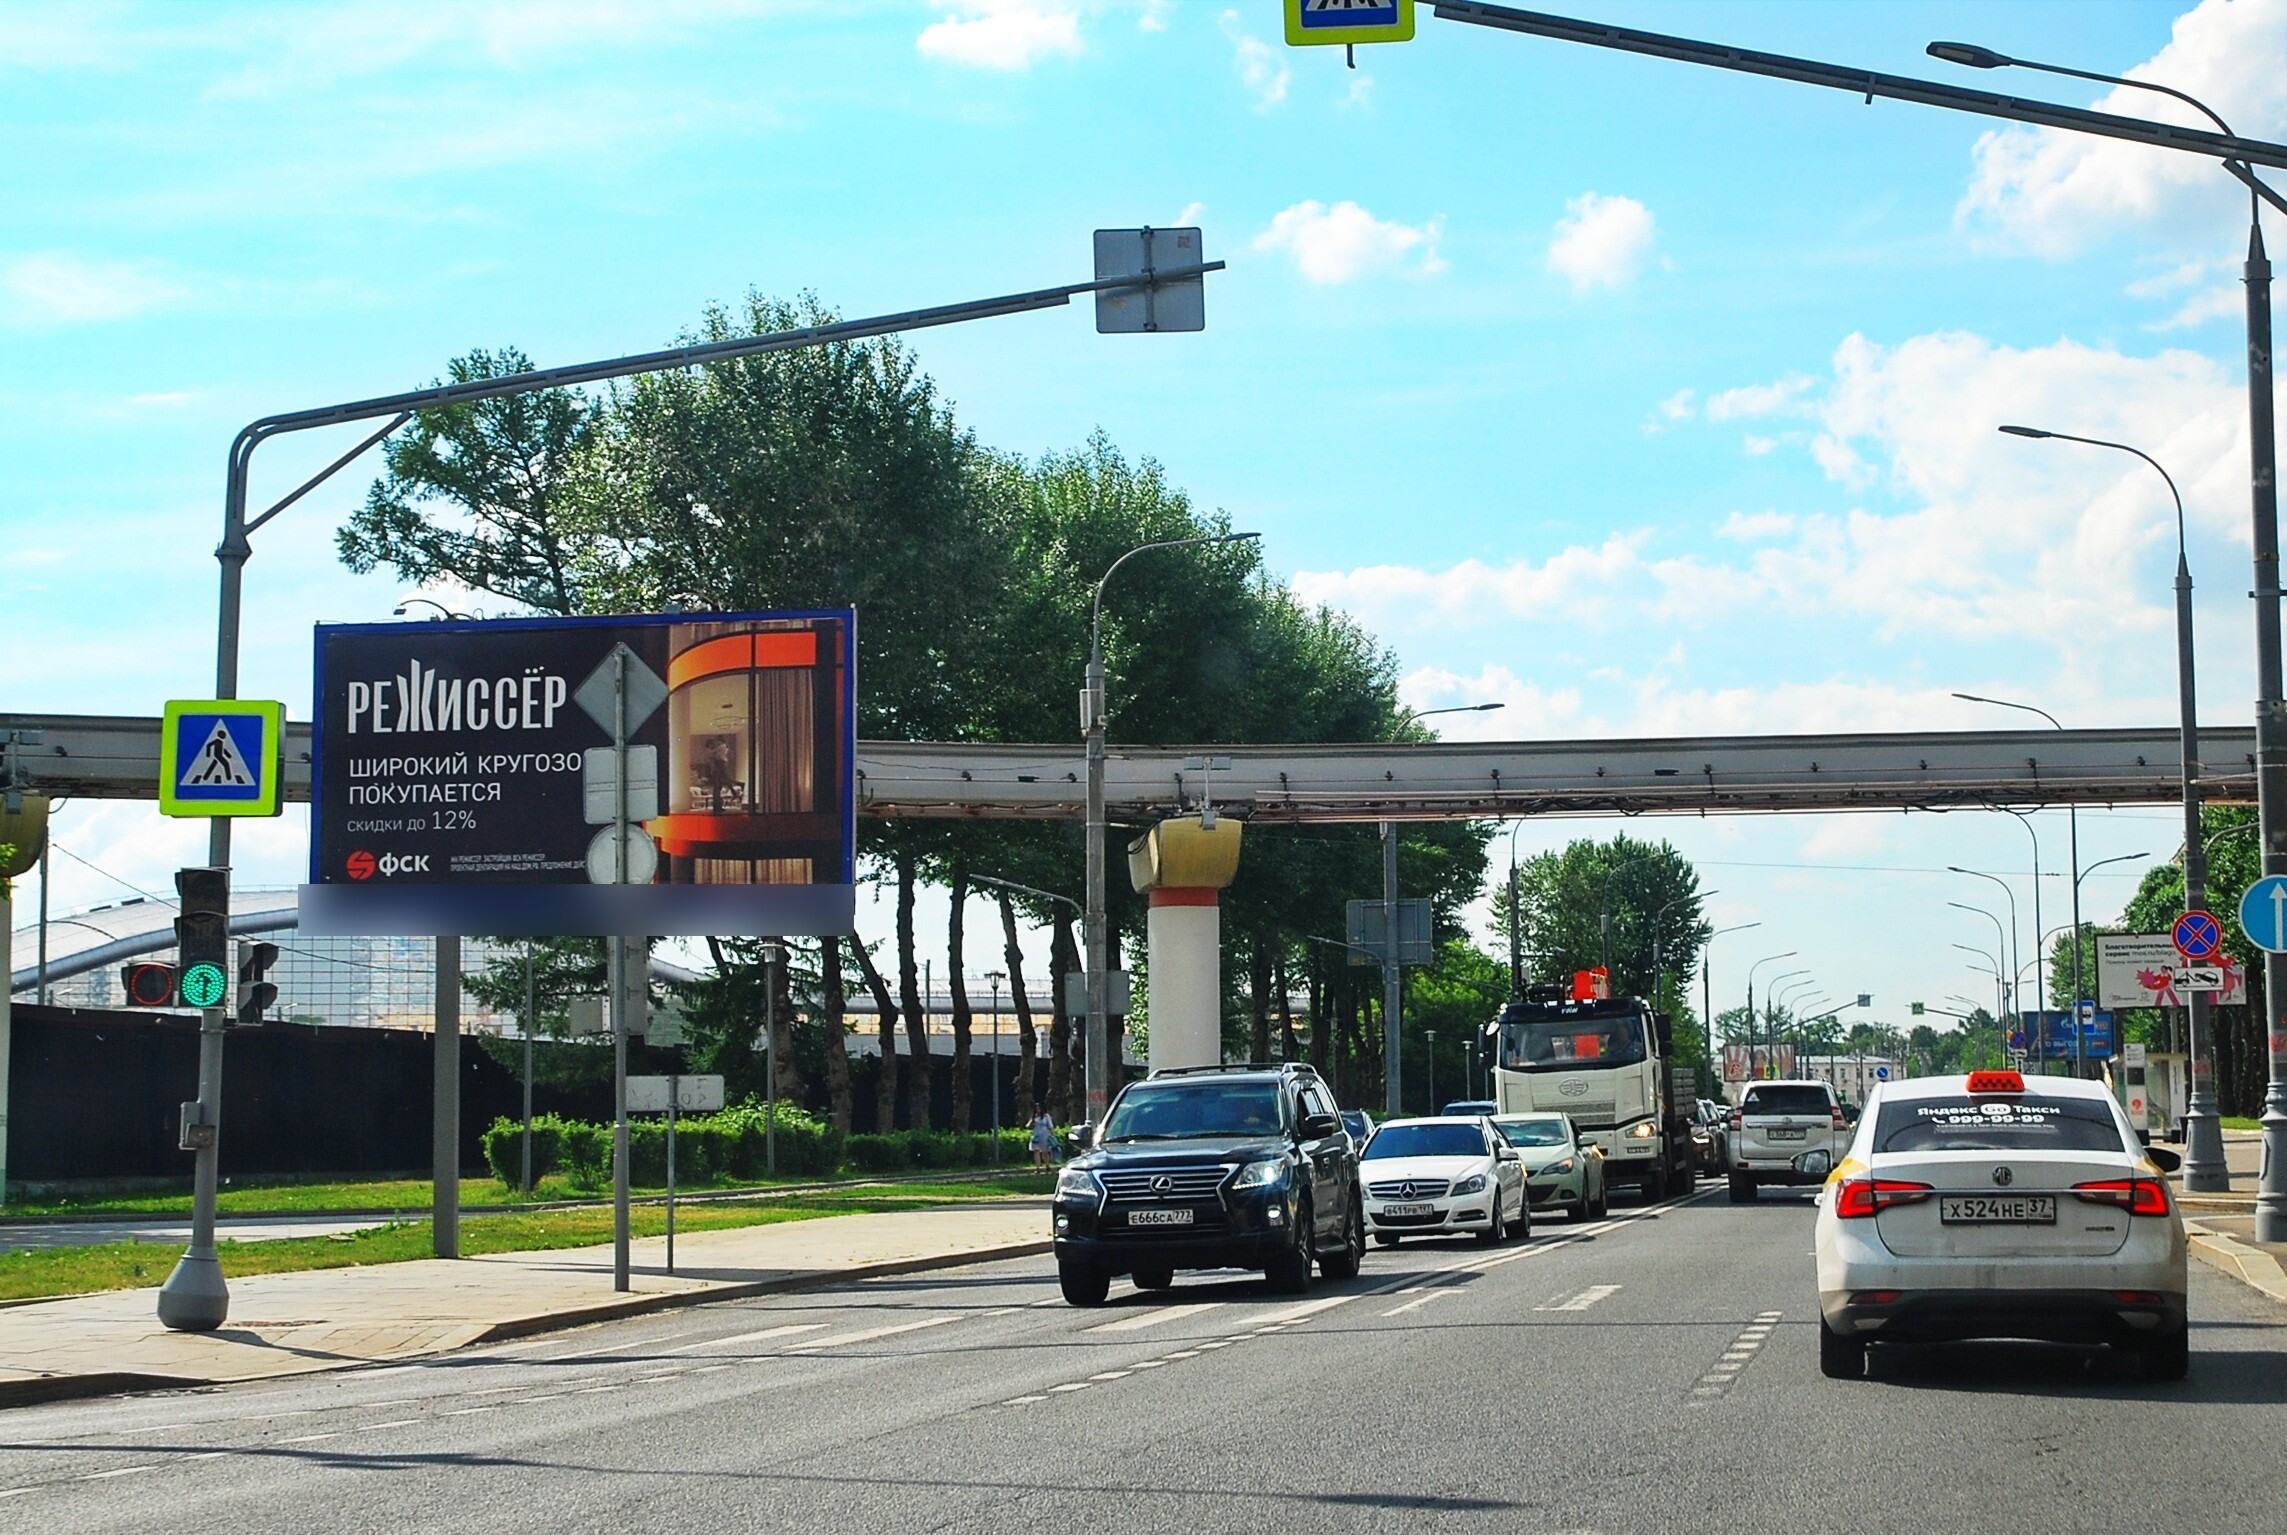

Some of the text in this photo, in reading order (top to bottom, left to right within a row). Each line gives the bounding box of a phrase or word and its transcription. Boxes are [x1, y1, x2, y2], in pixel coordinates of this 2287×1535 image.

[348, 657, 567, 734] РЕЖИССЁР
[349, 751, 582, 778] ШИРОКИЙ КРУГОЗО
[349, 782, 501, 805] ПОКУПАЕТСЯ
[432, 809, 477, 830] 12%
[1561, 1006, 1579, 1014] FAW
[1917, 1106, 1978, 1116] Яндекс
[2012, 1104, 2061, 1114] Такси
[1948, 1114, 2045, 1124] 999-99-99
